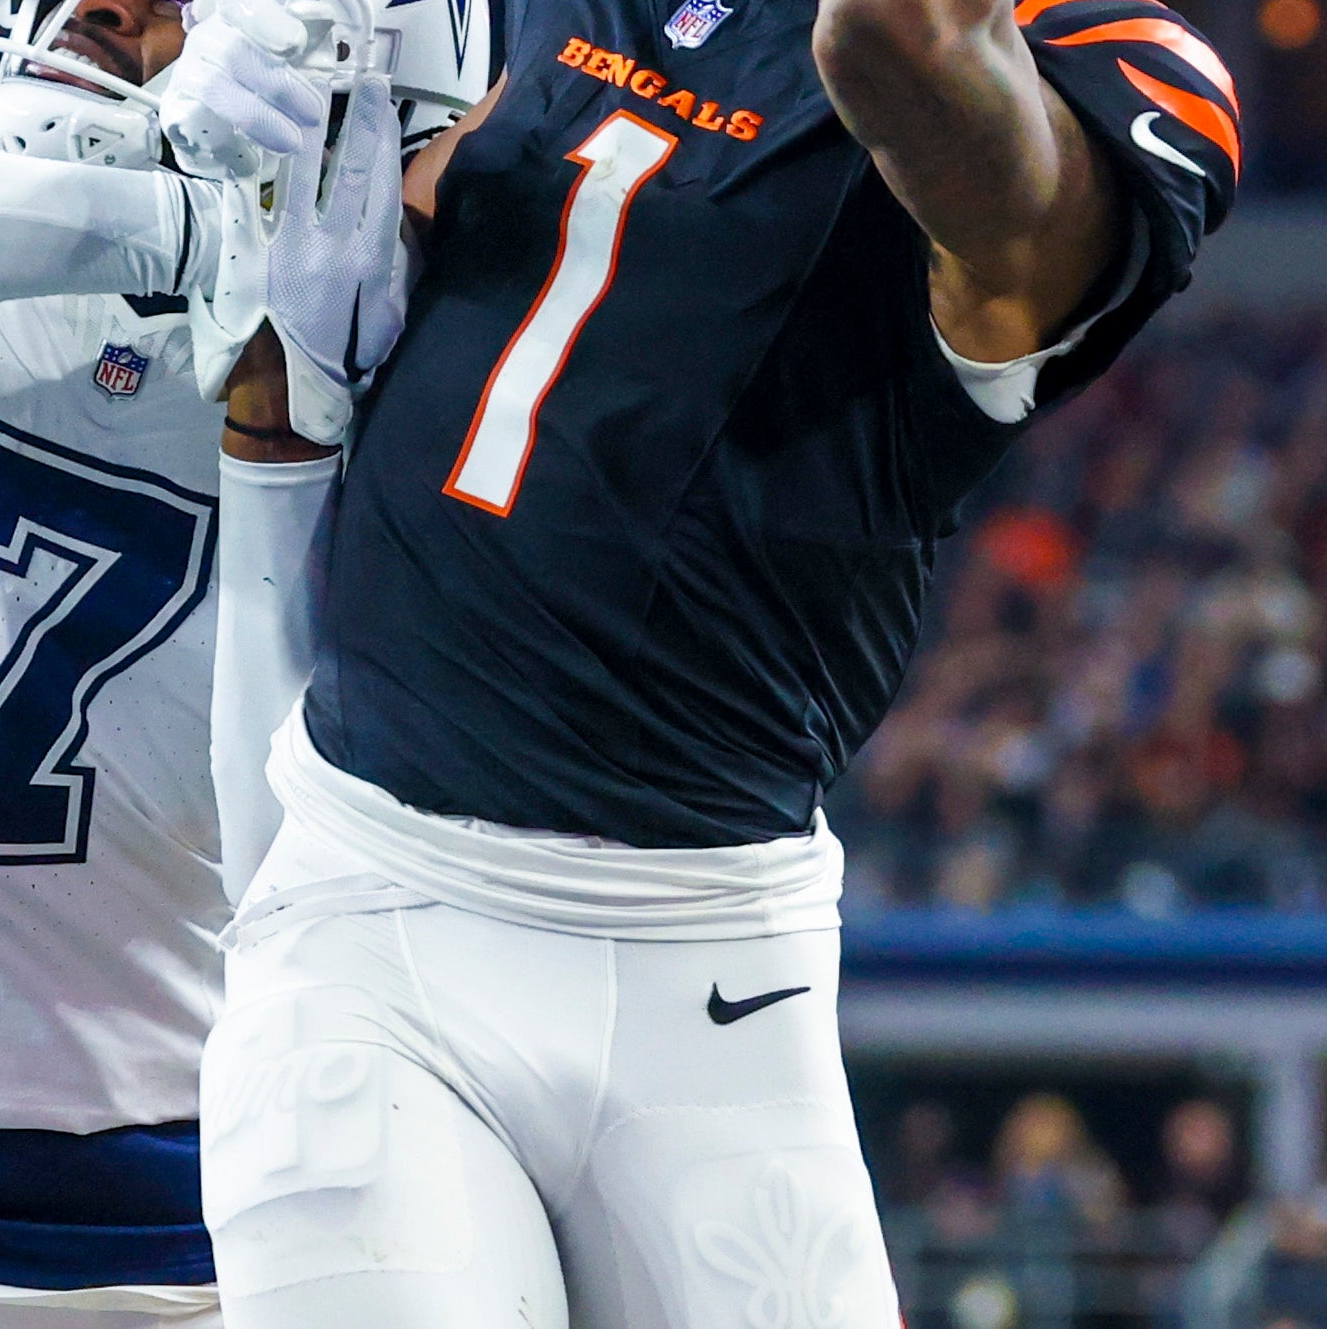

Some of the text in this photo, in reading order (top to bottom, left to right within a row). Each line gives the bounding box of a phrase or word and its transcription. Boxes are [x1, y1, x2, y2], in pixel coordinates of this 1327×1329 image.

[674, 11, 708, 39] NFL
[557, 37, 765, 142] BENGALS
[442, 108, 679, 517] 1
[98, 361, 136, 392] NFL
